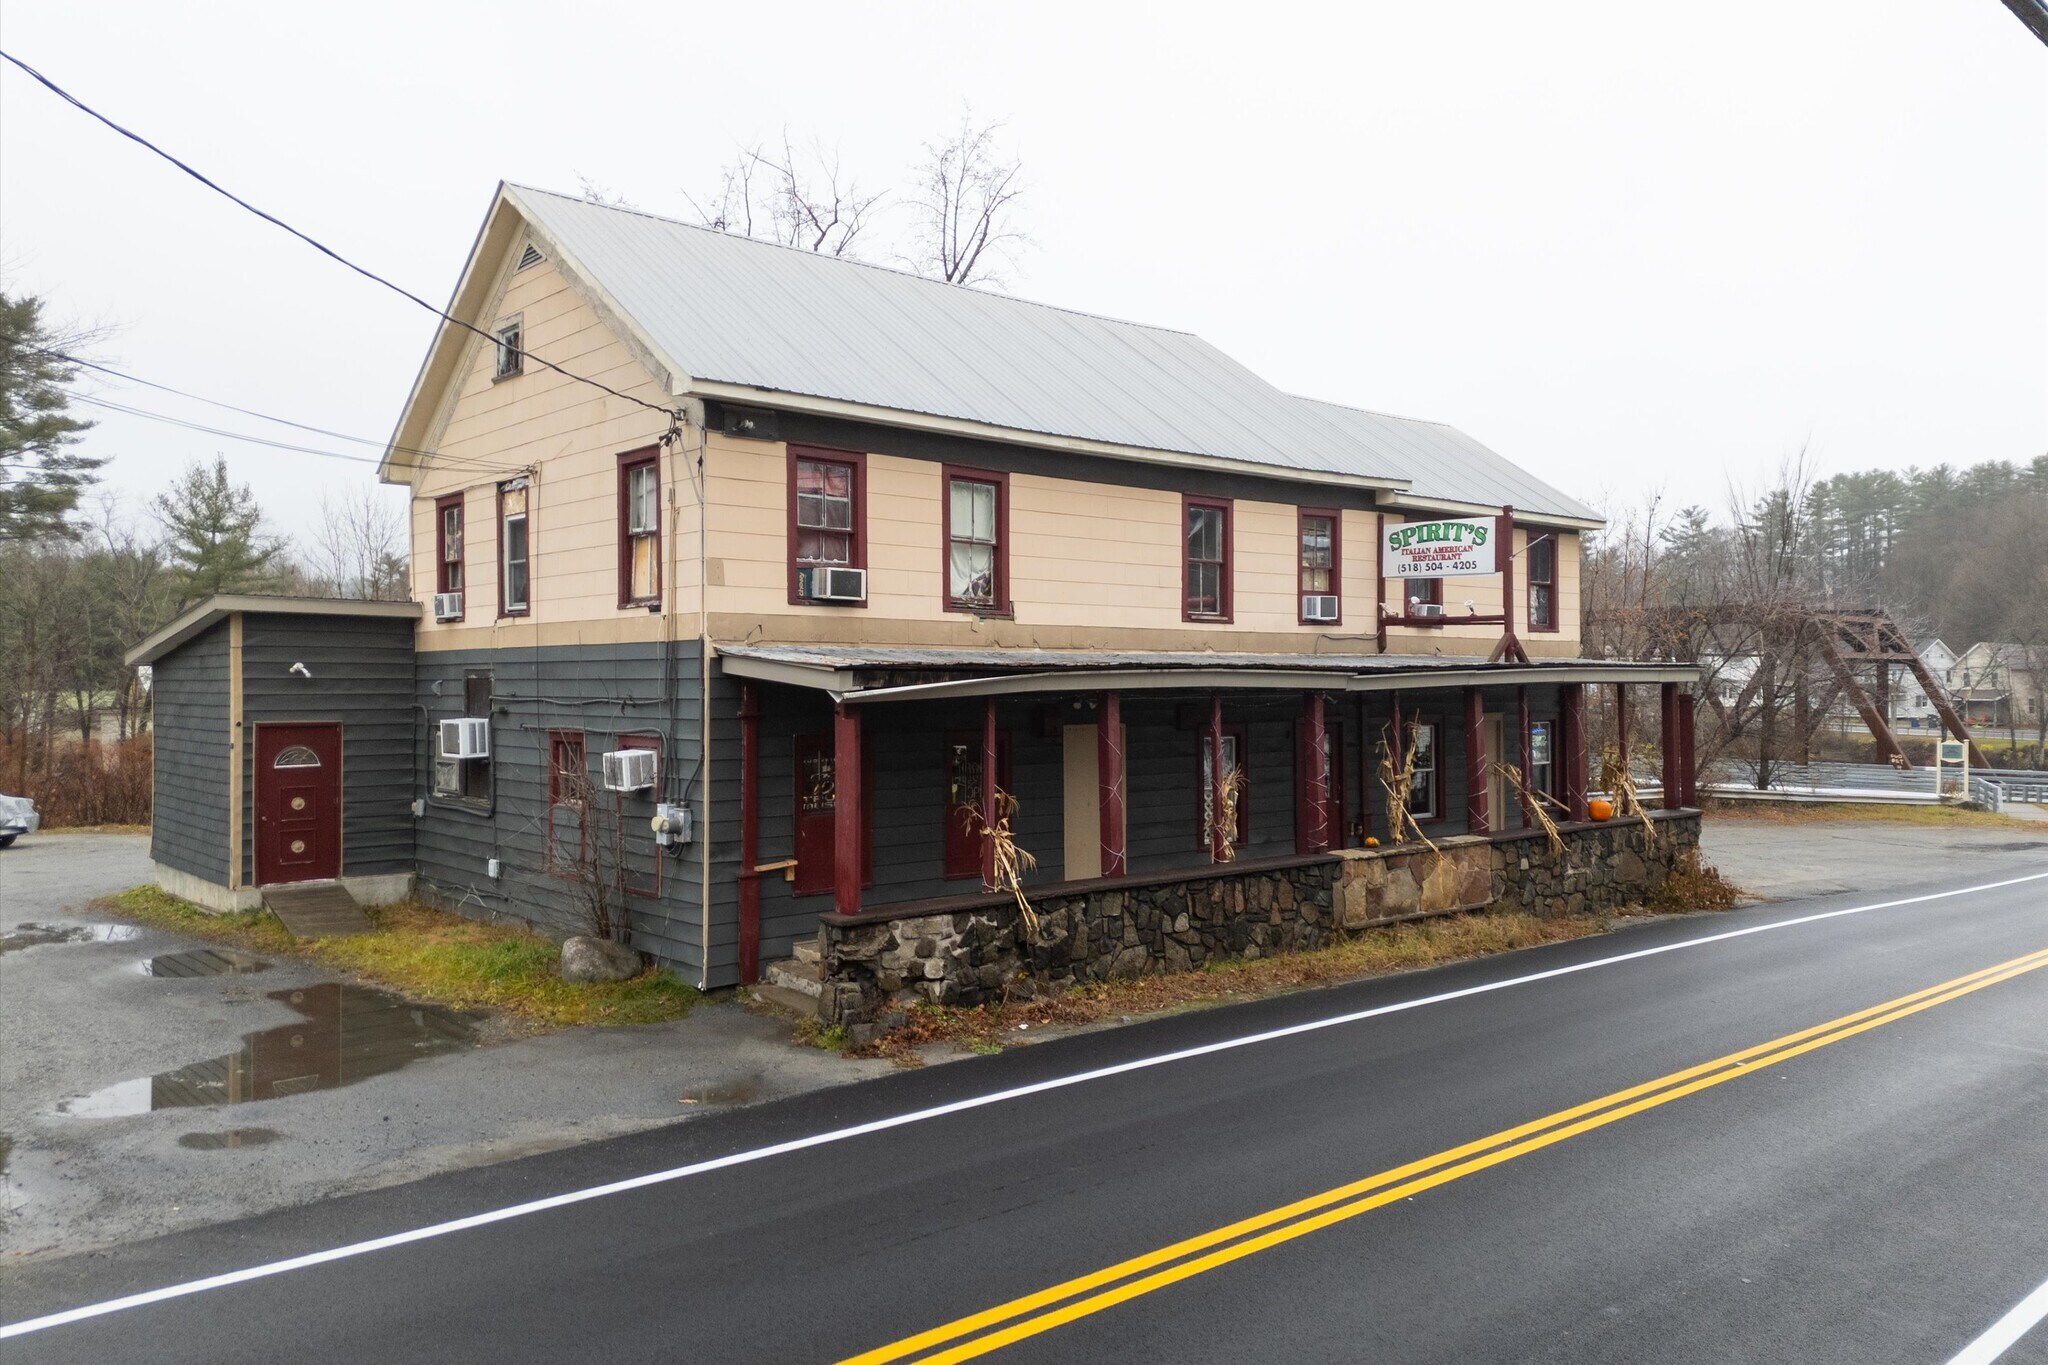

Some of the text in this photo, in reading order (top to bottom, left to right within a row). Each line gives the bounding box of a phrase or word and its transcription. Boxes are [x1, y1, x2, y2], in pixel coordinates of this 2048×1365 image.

[1389, 522, 1488, 552] SPIRIT'S
[1401, 545, 1473, 555] ITALIAN AMERICAN
[1412, 553, 1462, 562] RESTAURANT
[1398, 563, 1422, 574] (518)
[1425, 562, 1443, 571] 504
[1453, 560, 1477, 570] 4205
